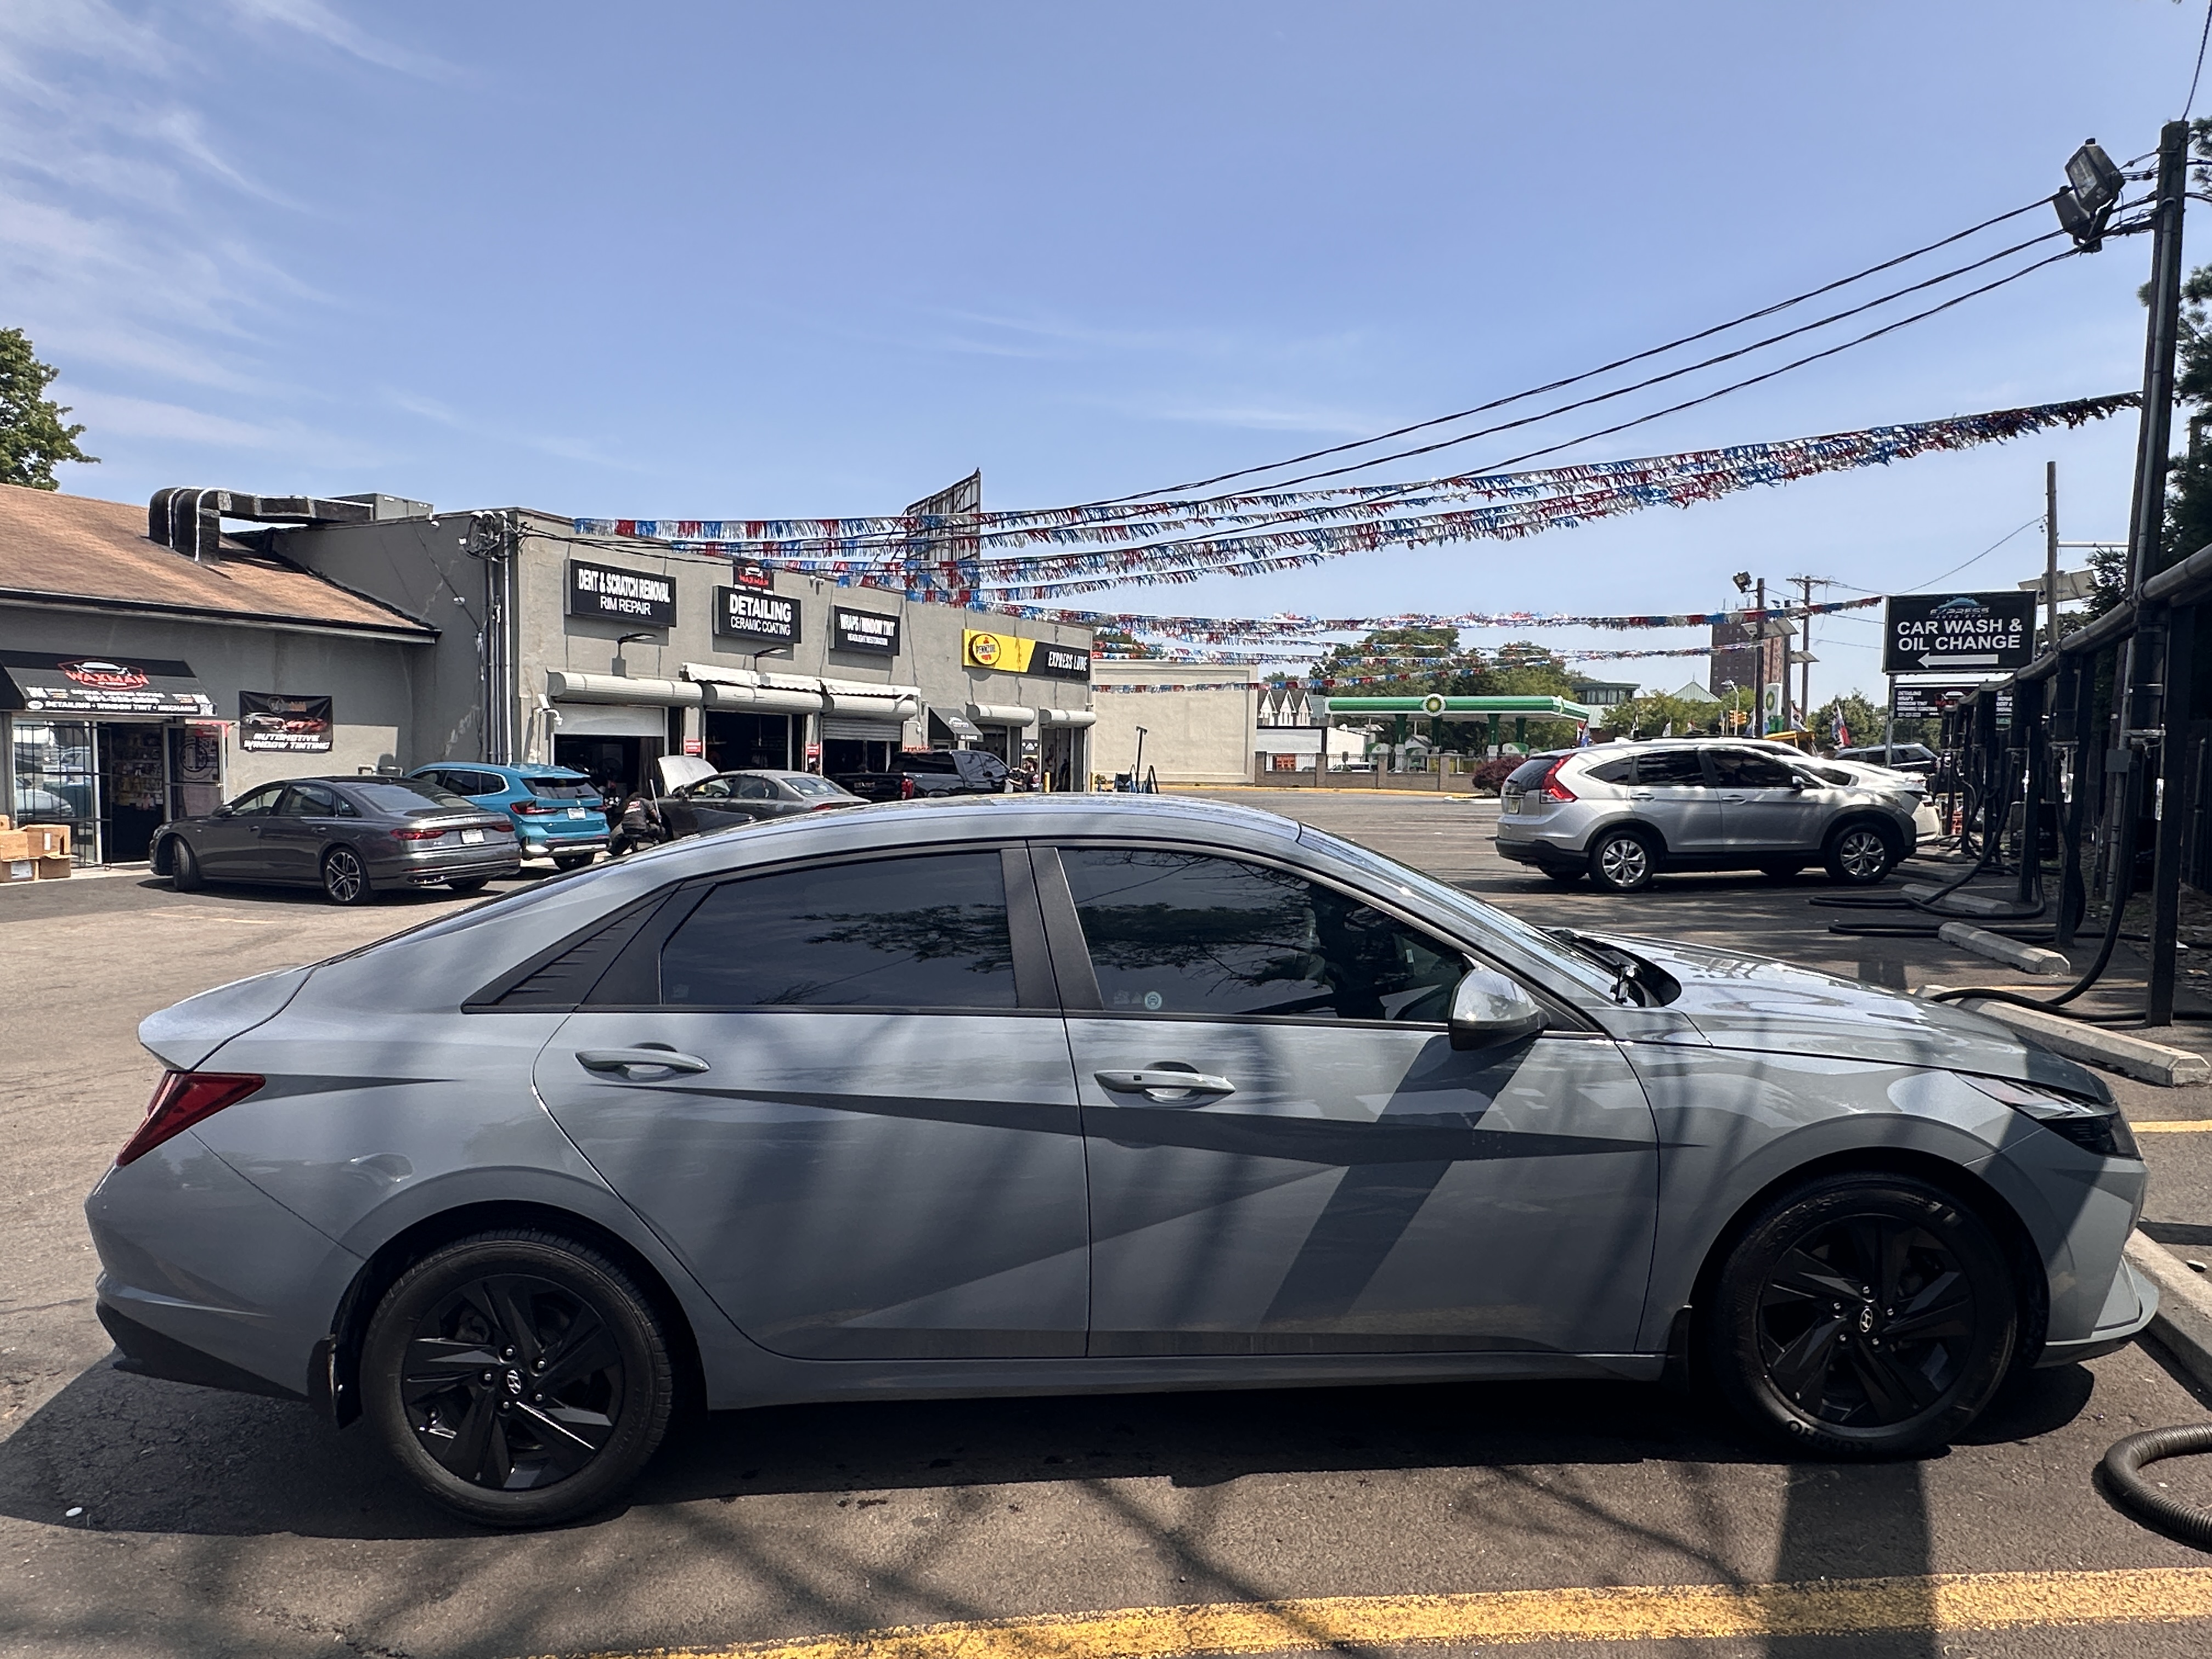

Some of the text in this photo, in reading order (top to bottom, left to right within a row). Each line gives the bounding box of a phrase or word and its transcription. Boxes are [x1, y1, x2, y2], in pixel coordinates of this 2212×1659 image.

[578, 568, 670, 603] DENT & SCRATCH REMOVAL
[601, 596, 651, 616] RIM REPAIR
[730, 594, 792, 622] DETAILING
[731, 616, 791, 636] CERAMIC COATING
[1897, 618, 2023, 635] CAR WASH &
[1898, 635, 2021, 651] OIL CHANGE
[1048, 651, 1088, 672] EXPRESS LUBE
[65, 670, 150, 684] WAXMAN
[244, 740, 289, 750] WINDOW
[253, 733, 320, 741] AUTOMOTIVE
